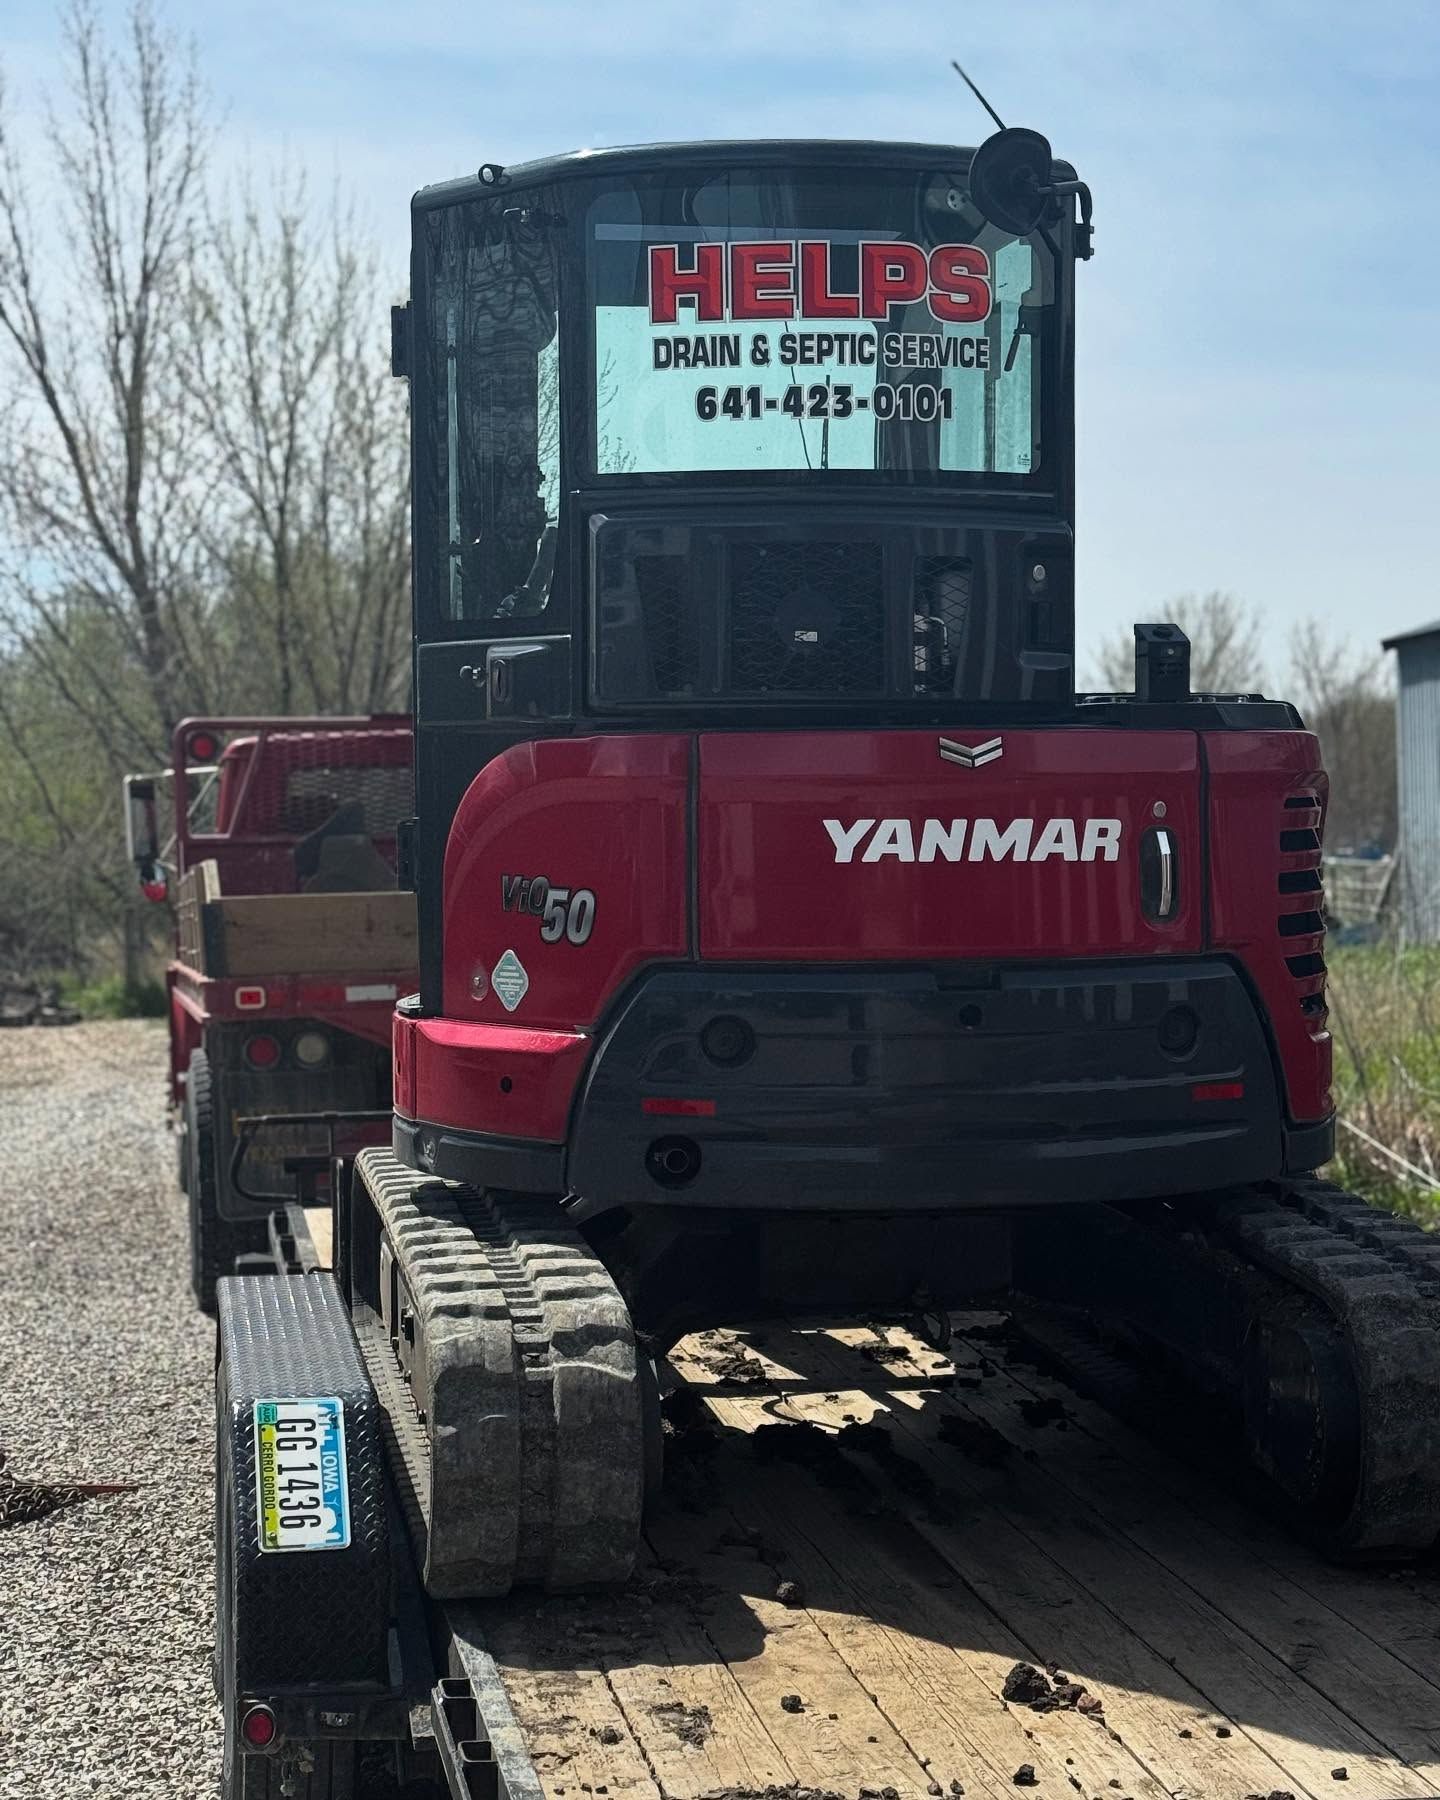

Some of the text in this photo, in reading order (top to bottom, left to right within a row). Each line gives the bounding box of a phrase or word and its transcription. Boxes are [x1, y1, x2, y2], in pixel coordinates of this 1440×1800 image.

[648, 240, 993, 324] HELPS
[652, 333, 991, 371] DRAIN & SEPTIC SERVICE
[695, 382, 954, 423] 641-423-0101
[822, 818, 1122, 863] YANMAR
[262, 1441, 276, 1510] CERRO GORDO
[275, 1418, 322, 1529] GG 1436
[322, 1451, 338, 1493] IOWA
